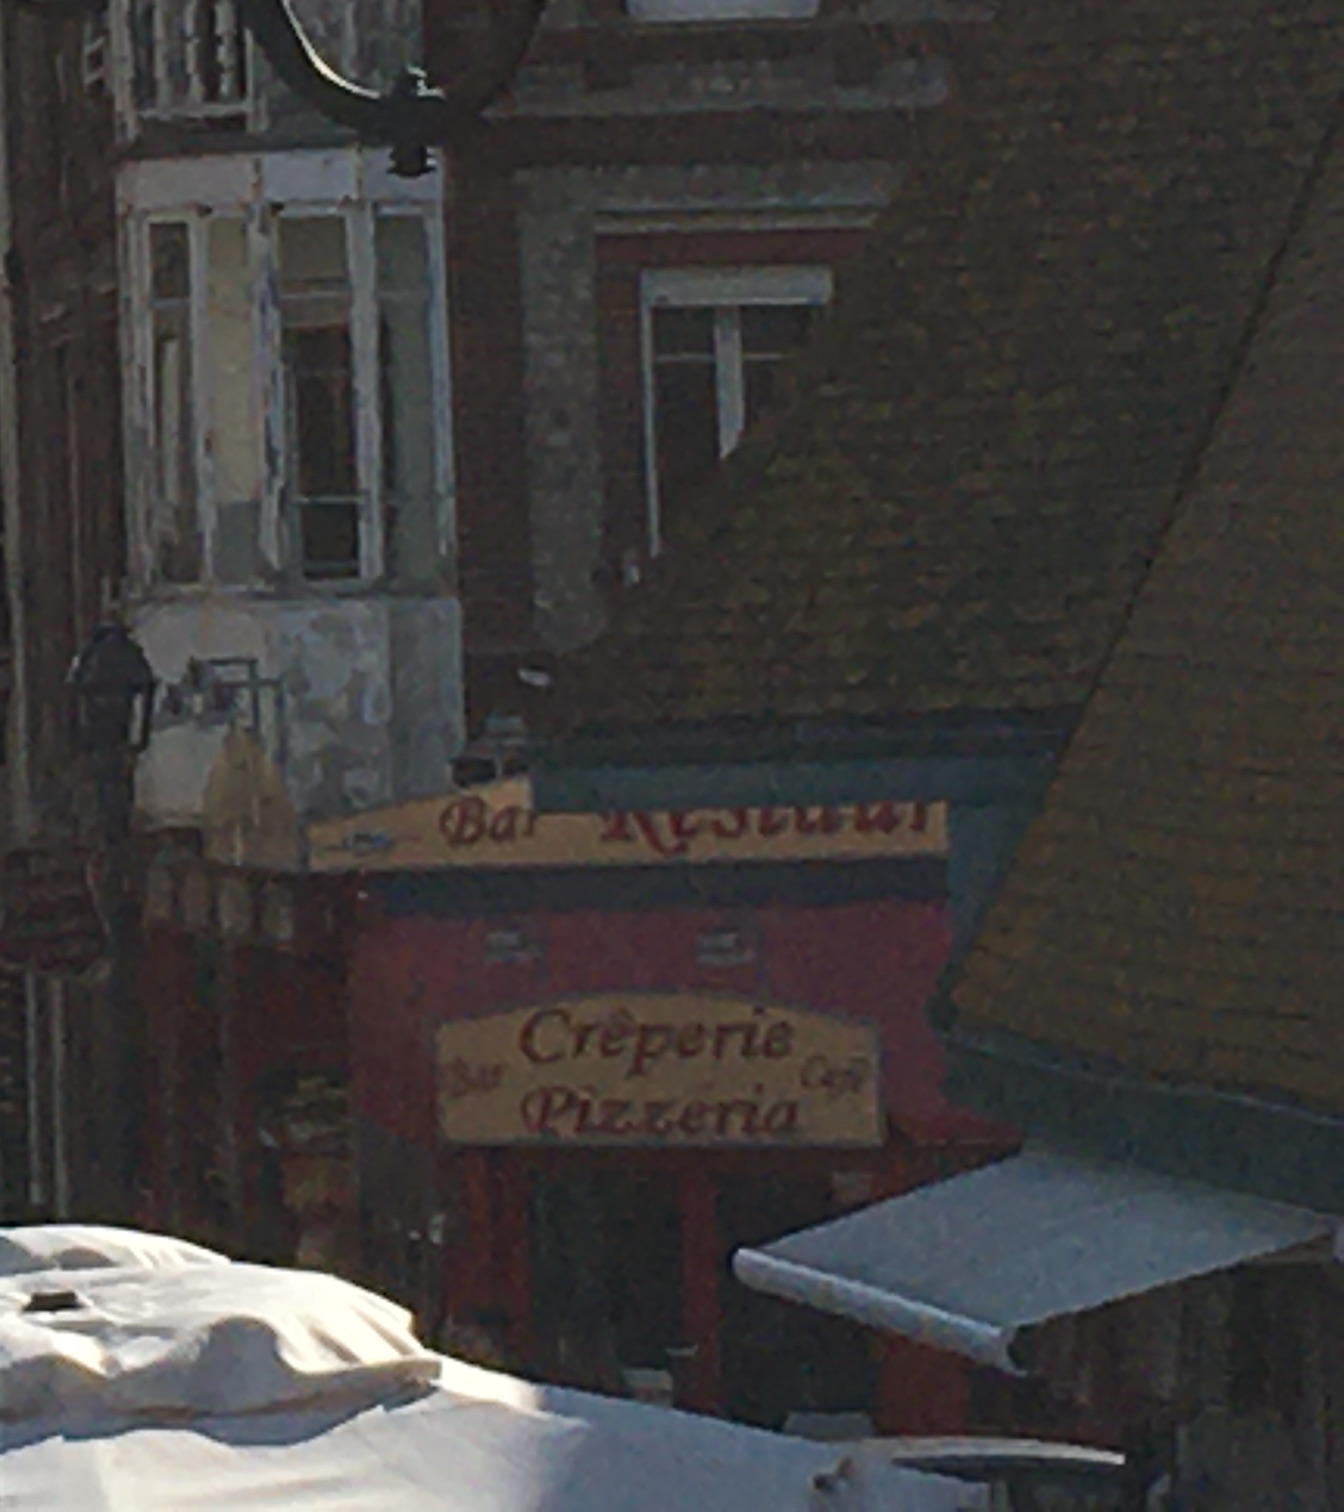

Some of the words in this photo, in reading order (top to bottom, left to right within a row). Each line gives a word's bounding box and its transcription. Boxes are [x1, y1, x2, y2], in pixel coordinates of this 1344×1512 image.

[438, 795, 536, 848] Bar
[518, 1005, 796, 1076] Crêperie
[520, 1083, 802, 1135] Pizzeria
